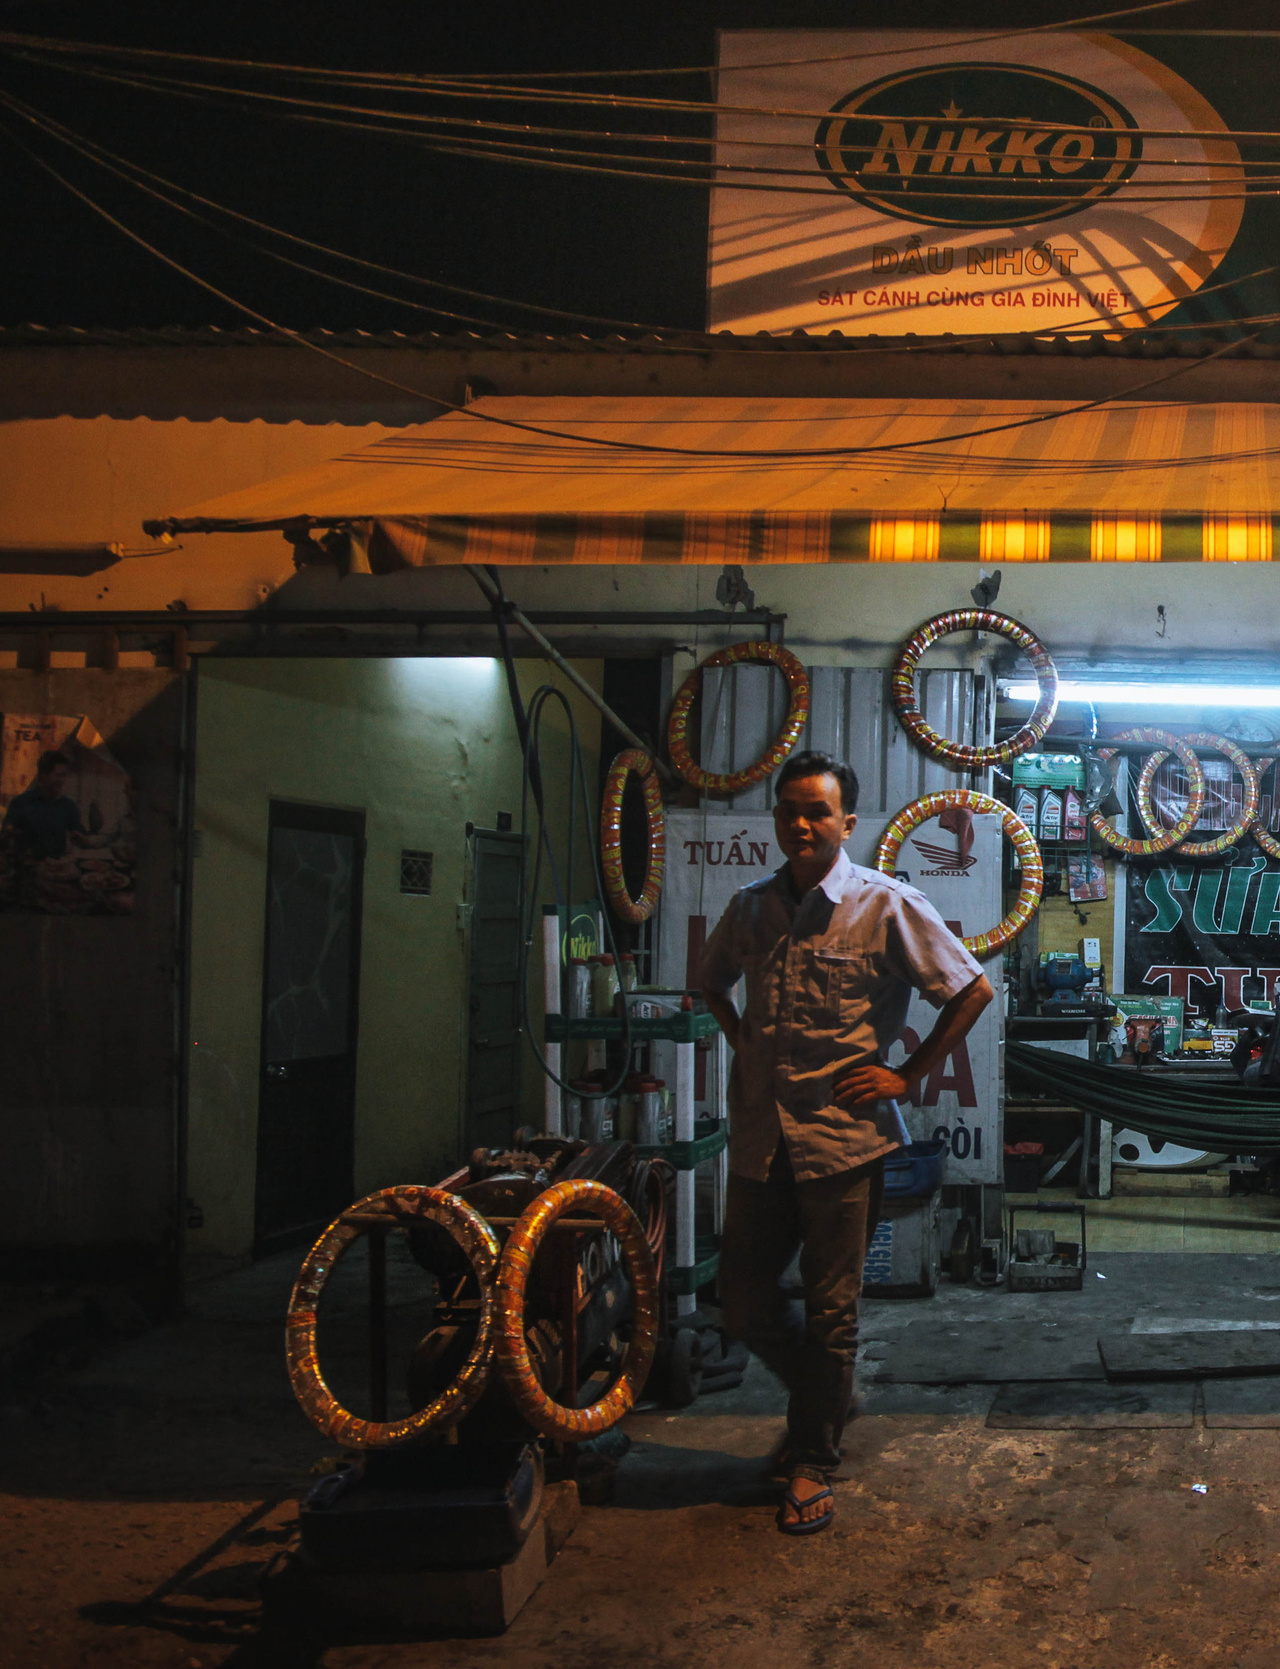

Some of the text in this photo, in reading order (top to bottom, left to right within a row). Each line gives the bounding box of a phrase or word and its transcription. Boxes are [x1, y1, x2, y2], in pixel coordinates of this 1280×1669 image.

[872, 234, 1079, 276] DẦU NHỚT
[817, 286, 1132, 311] SÁT CÁNH CÙNG GIA ĐÌNH VIỆT
[683, 829, 769, 866] TUẤN
[919, 868, 971, 877] HONDA
[932, 1117, 982, 1160] CÒI
